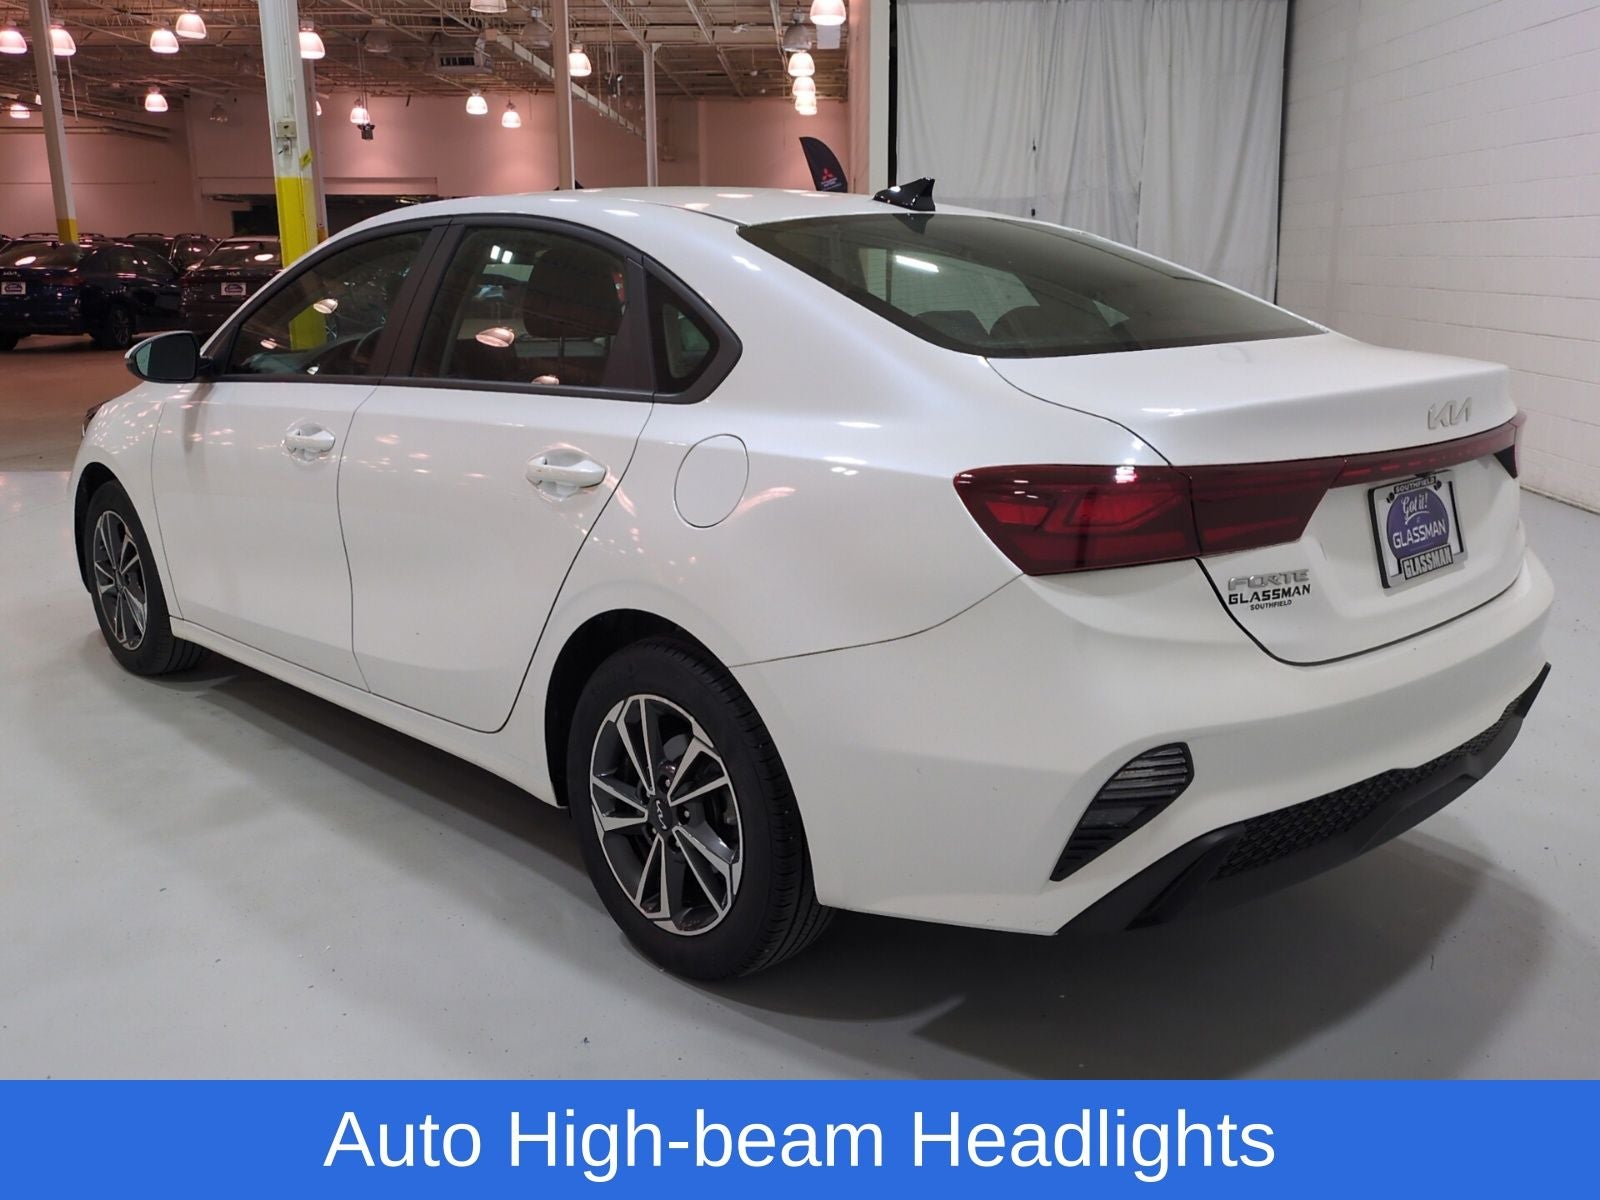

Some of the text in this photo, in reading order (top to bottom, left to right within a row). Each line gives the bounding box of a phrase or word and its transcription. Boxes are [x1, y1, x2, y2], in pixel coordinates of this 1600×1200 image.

[1427, 396, 1472, 430] KIA
[1394, 477, 1435, 493] SOUTHFIELD
[1401, 496, 1418, 519] Got
[1392, 519, 1447, 549] GLASSMAN
[1403, 547, 1452, 579] GLASSMAN
[1228, 569, 1310, 591] FORTE
[1228, 584, 1311, 605] GLASSMAN
[1250, 600, 1293, 611] SOUTHFIELD
